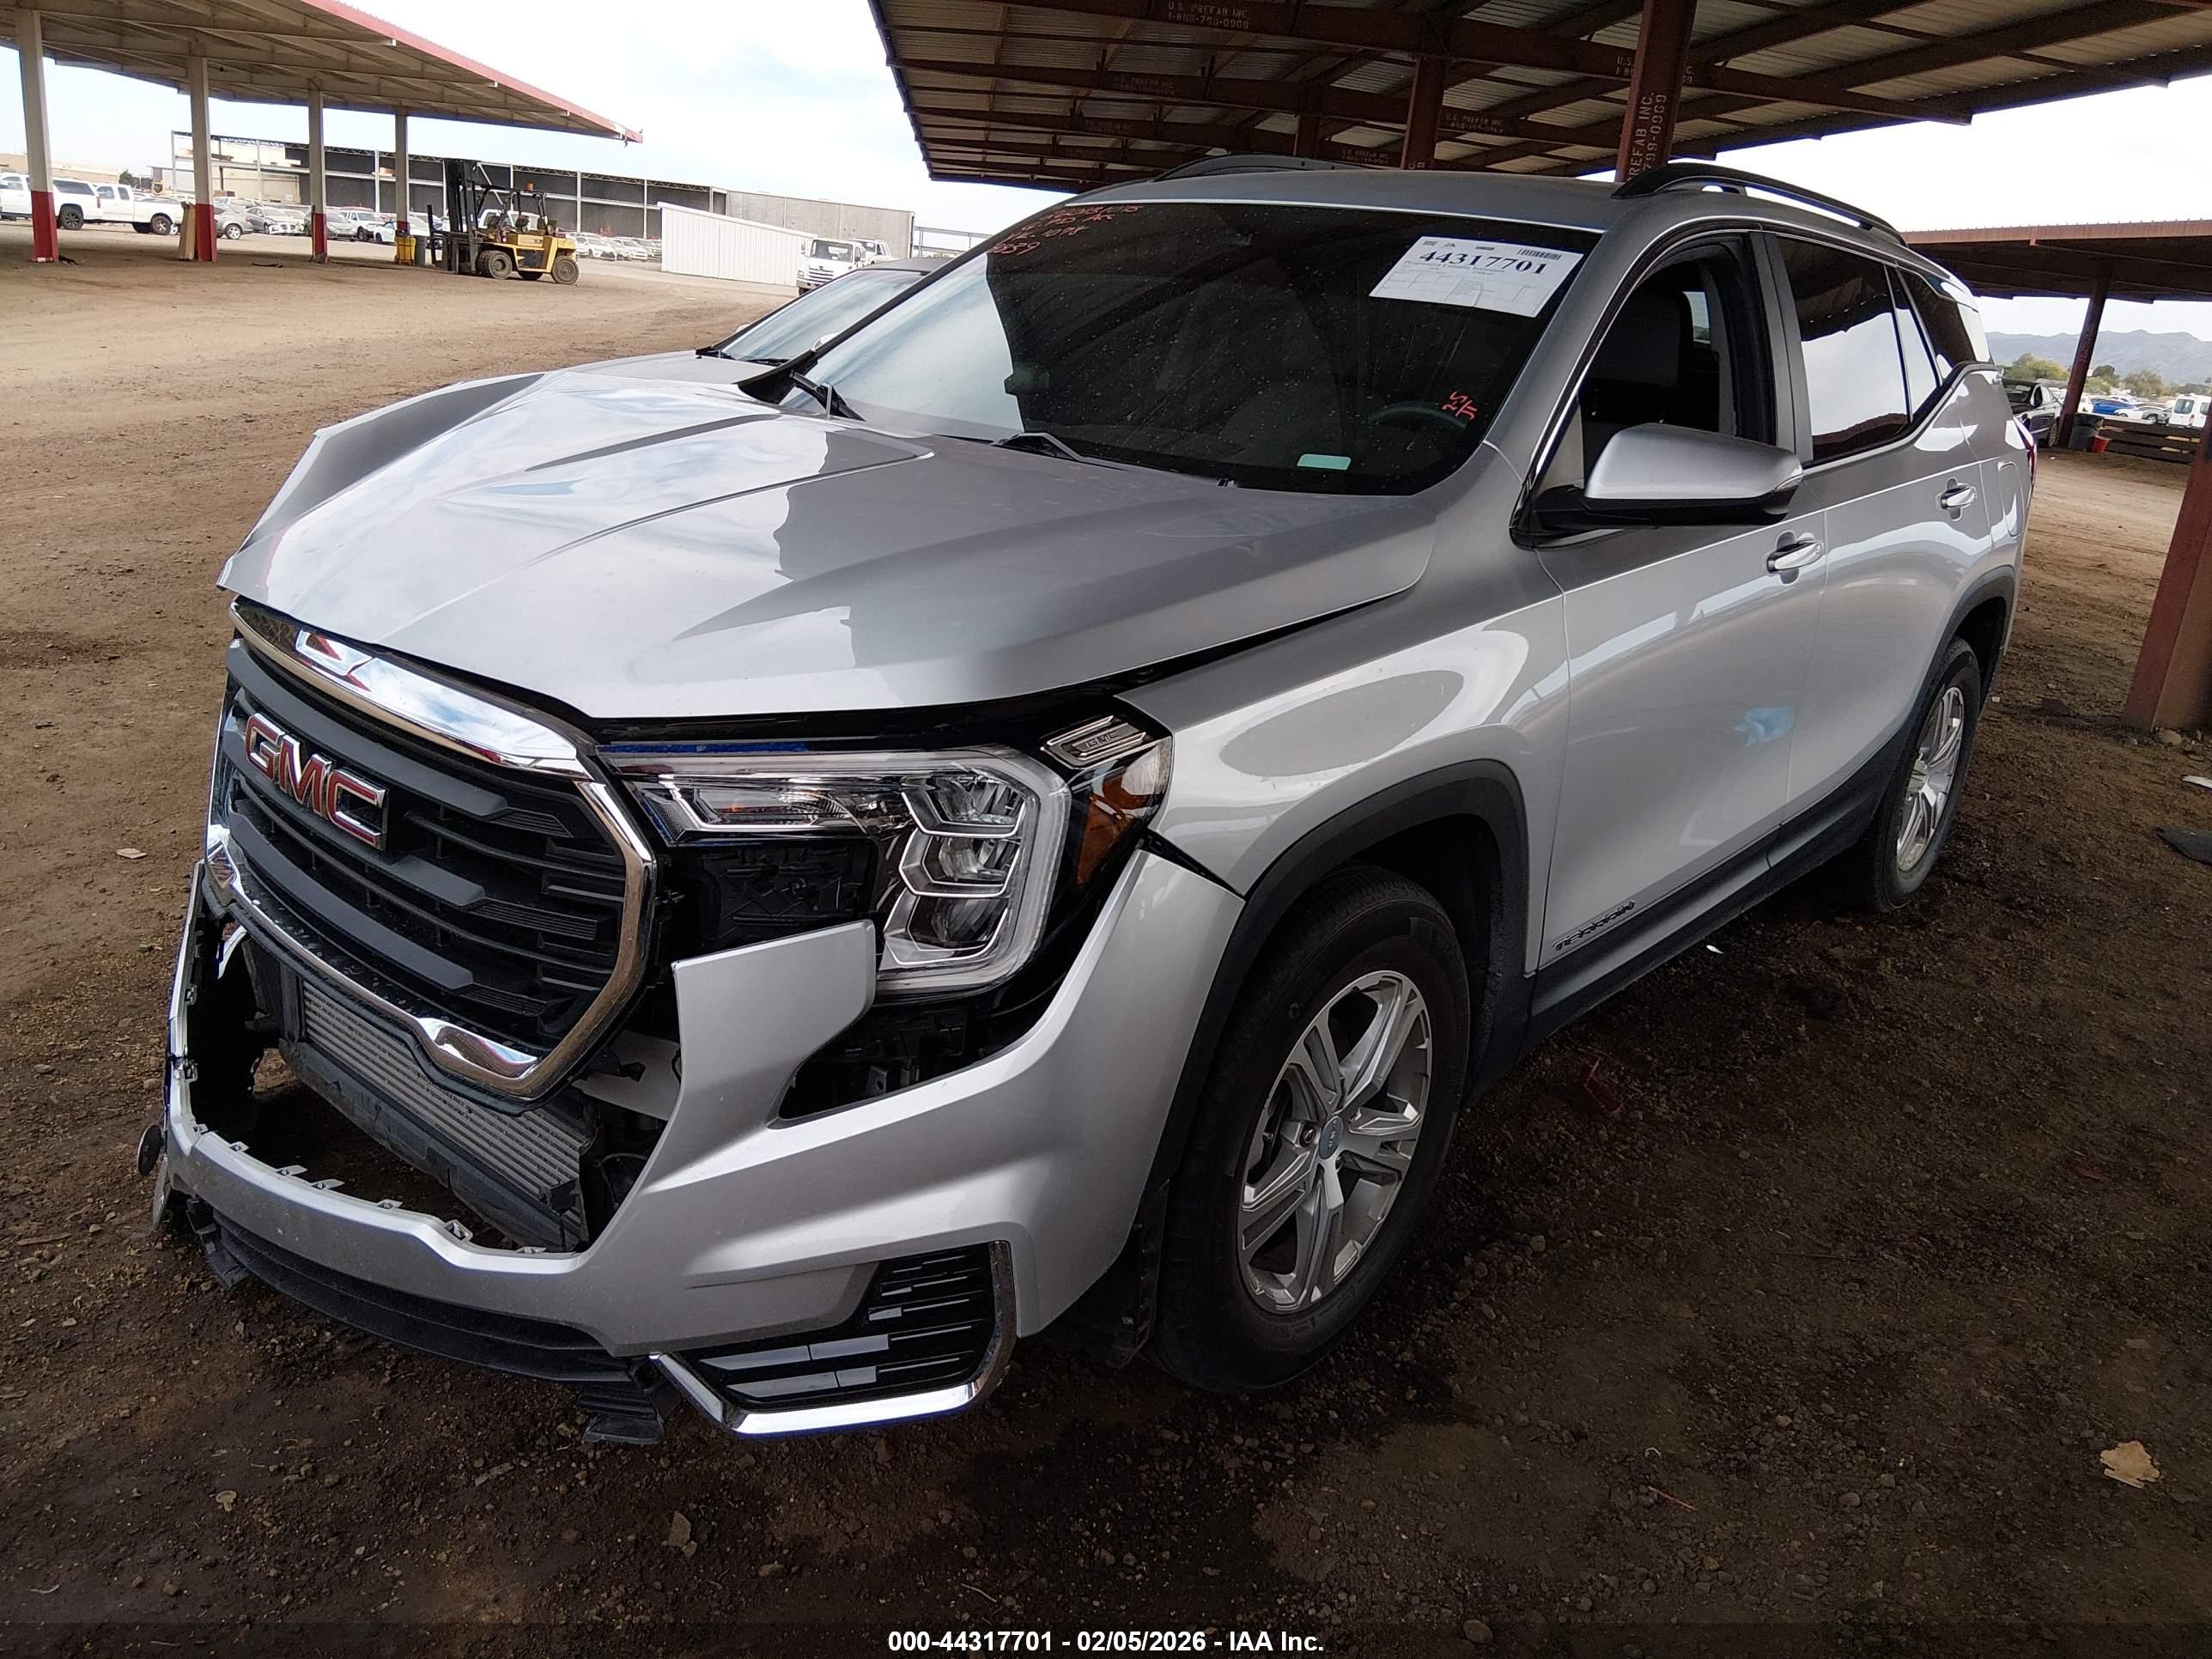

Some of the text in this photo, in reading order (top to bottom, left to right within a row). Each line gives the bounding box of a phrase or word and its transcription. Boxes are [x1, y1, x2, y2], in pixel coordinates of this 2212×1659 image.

[1638, 92, 1654, 120] INC.
[1419, 251, 1547, 274] 44317701
[1085, 731, 1121, 749] GMC
[246, 713, 387, 850] GMC
